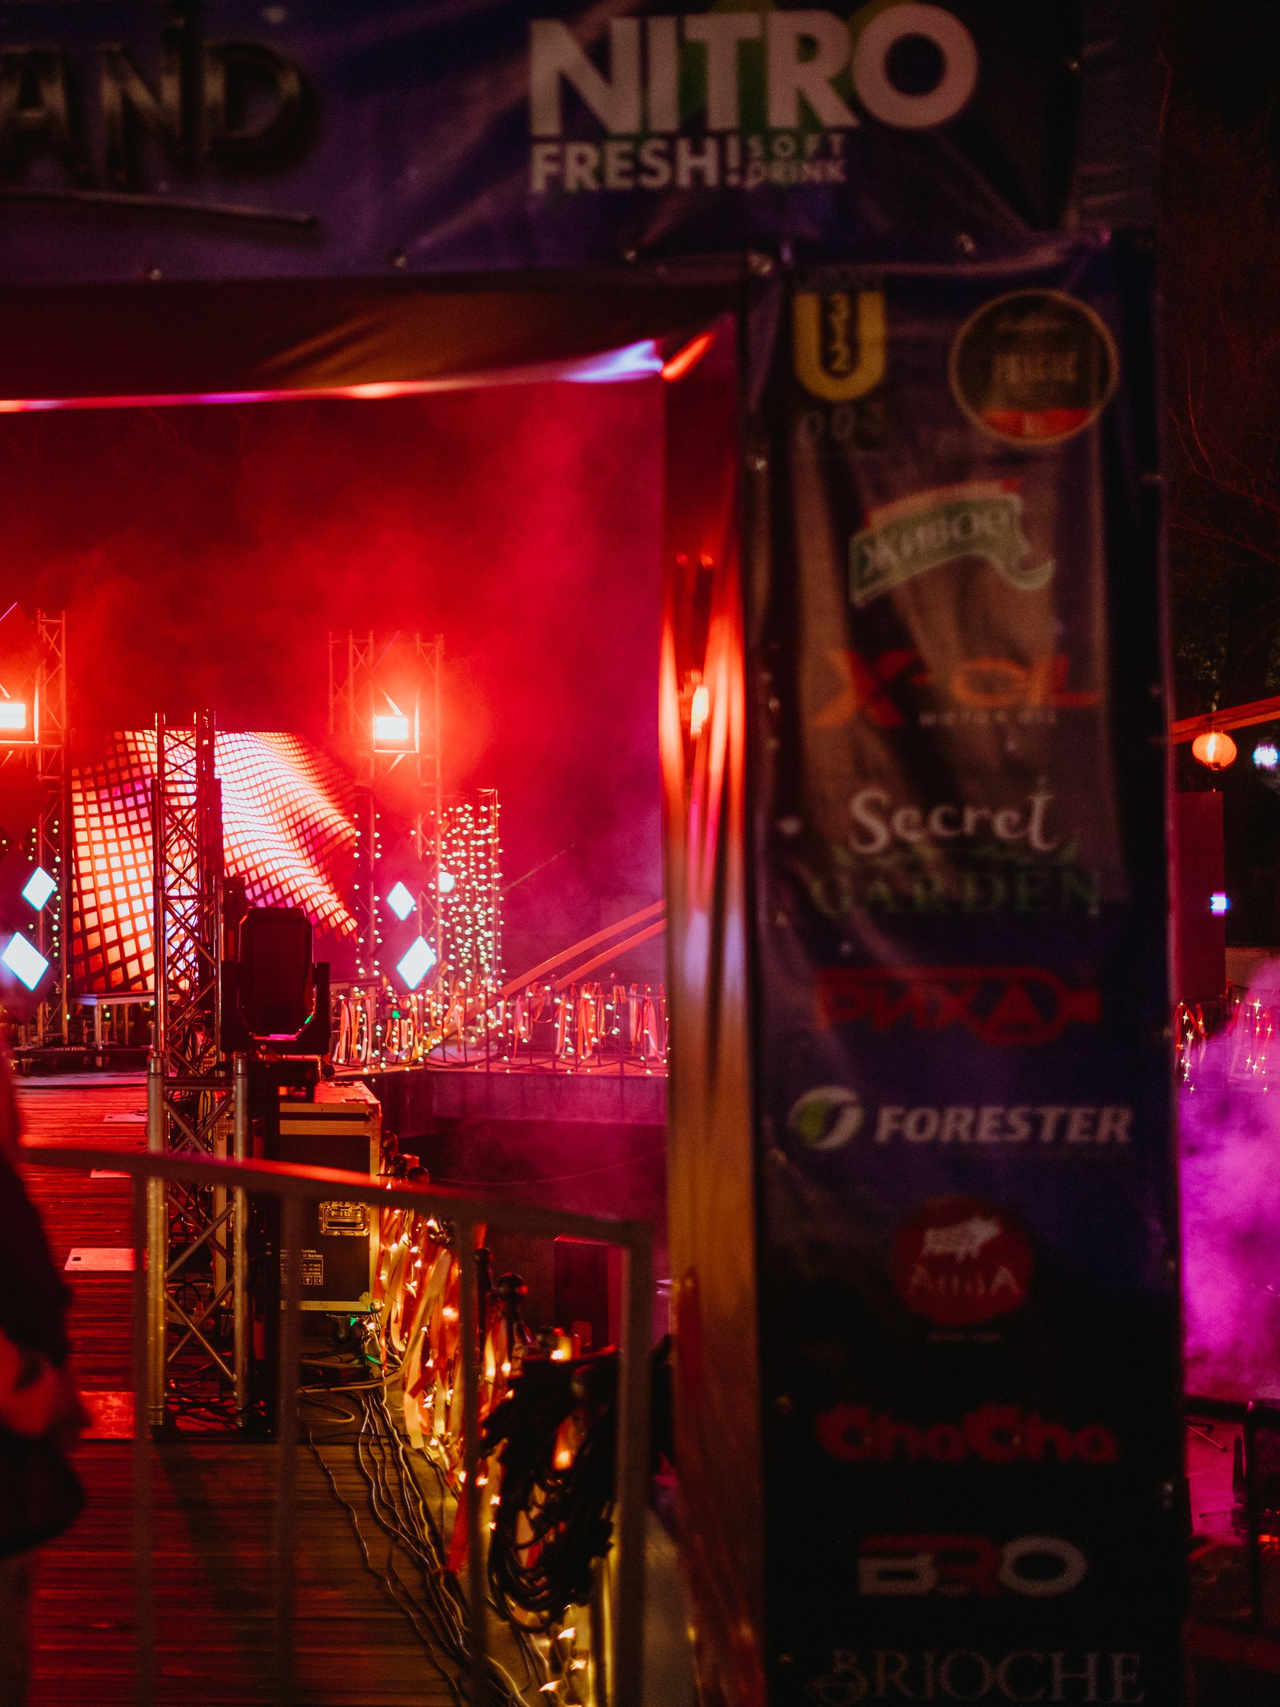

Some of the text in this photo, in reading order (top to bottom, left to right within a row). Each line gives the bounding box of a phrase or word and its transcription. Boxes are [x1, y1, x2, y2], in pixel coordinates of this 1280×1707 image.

[527, 4, 980, 141] NITRO
[528, 129, 741, 193] FRESH!
[742, 157, 847, 191] DRINK
[745, 132, 846, 162] SOFT
[848, 780, 1062, 856] Secret
[874, 1103, 1136, 1145] FORESTER
[804, 1647, 1148, 1705] BRIOCHE
